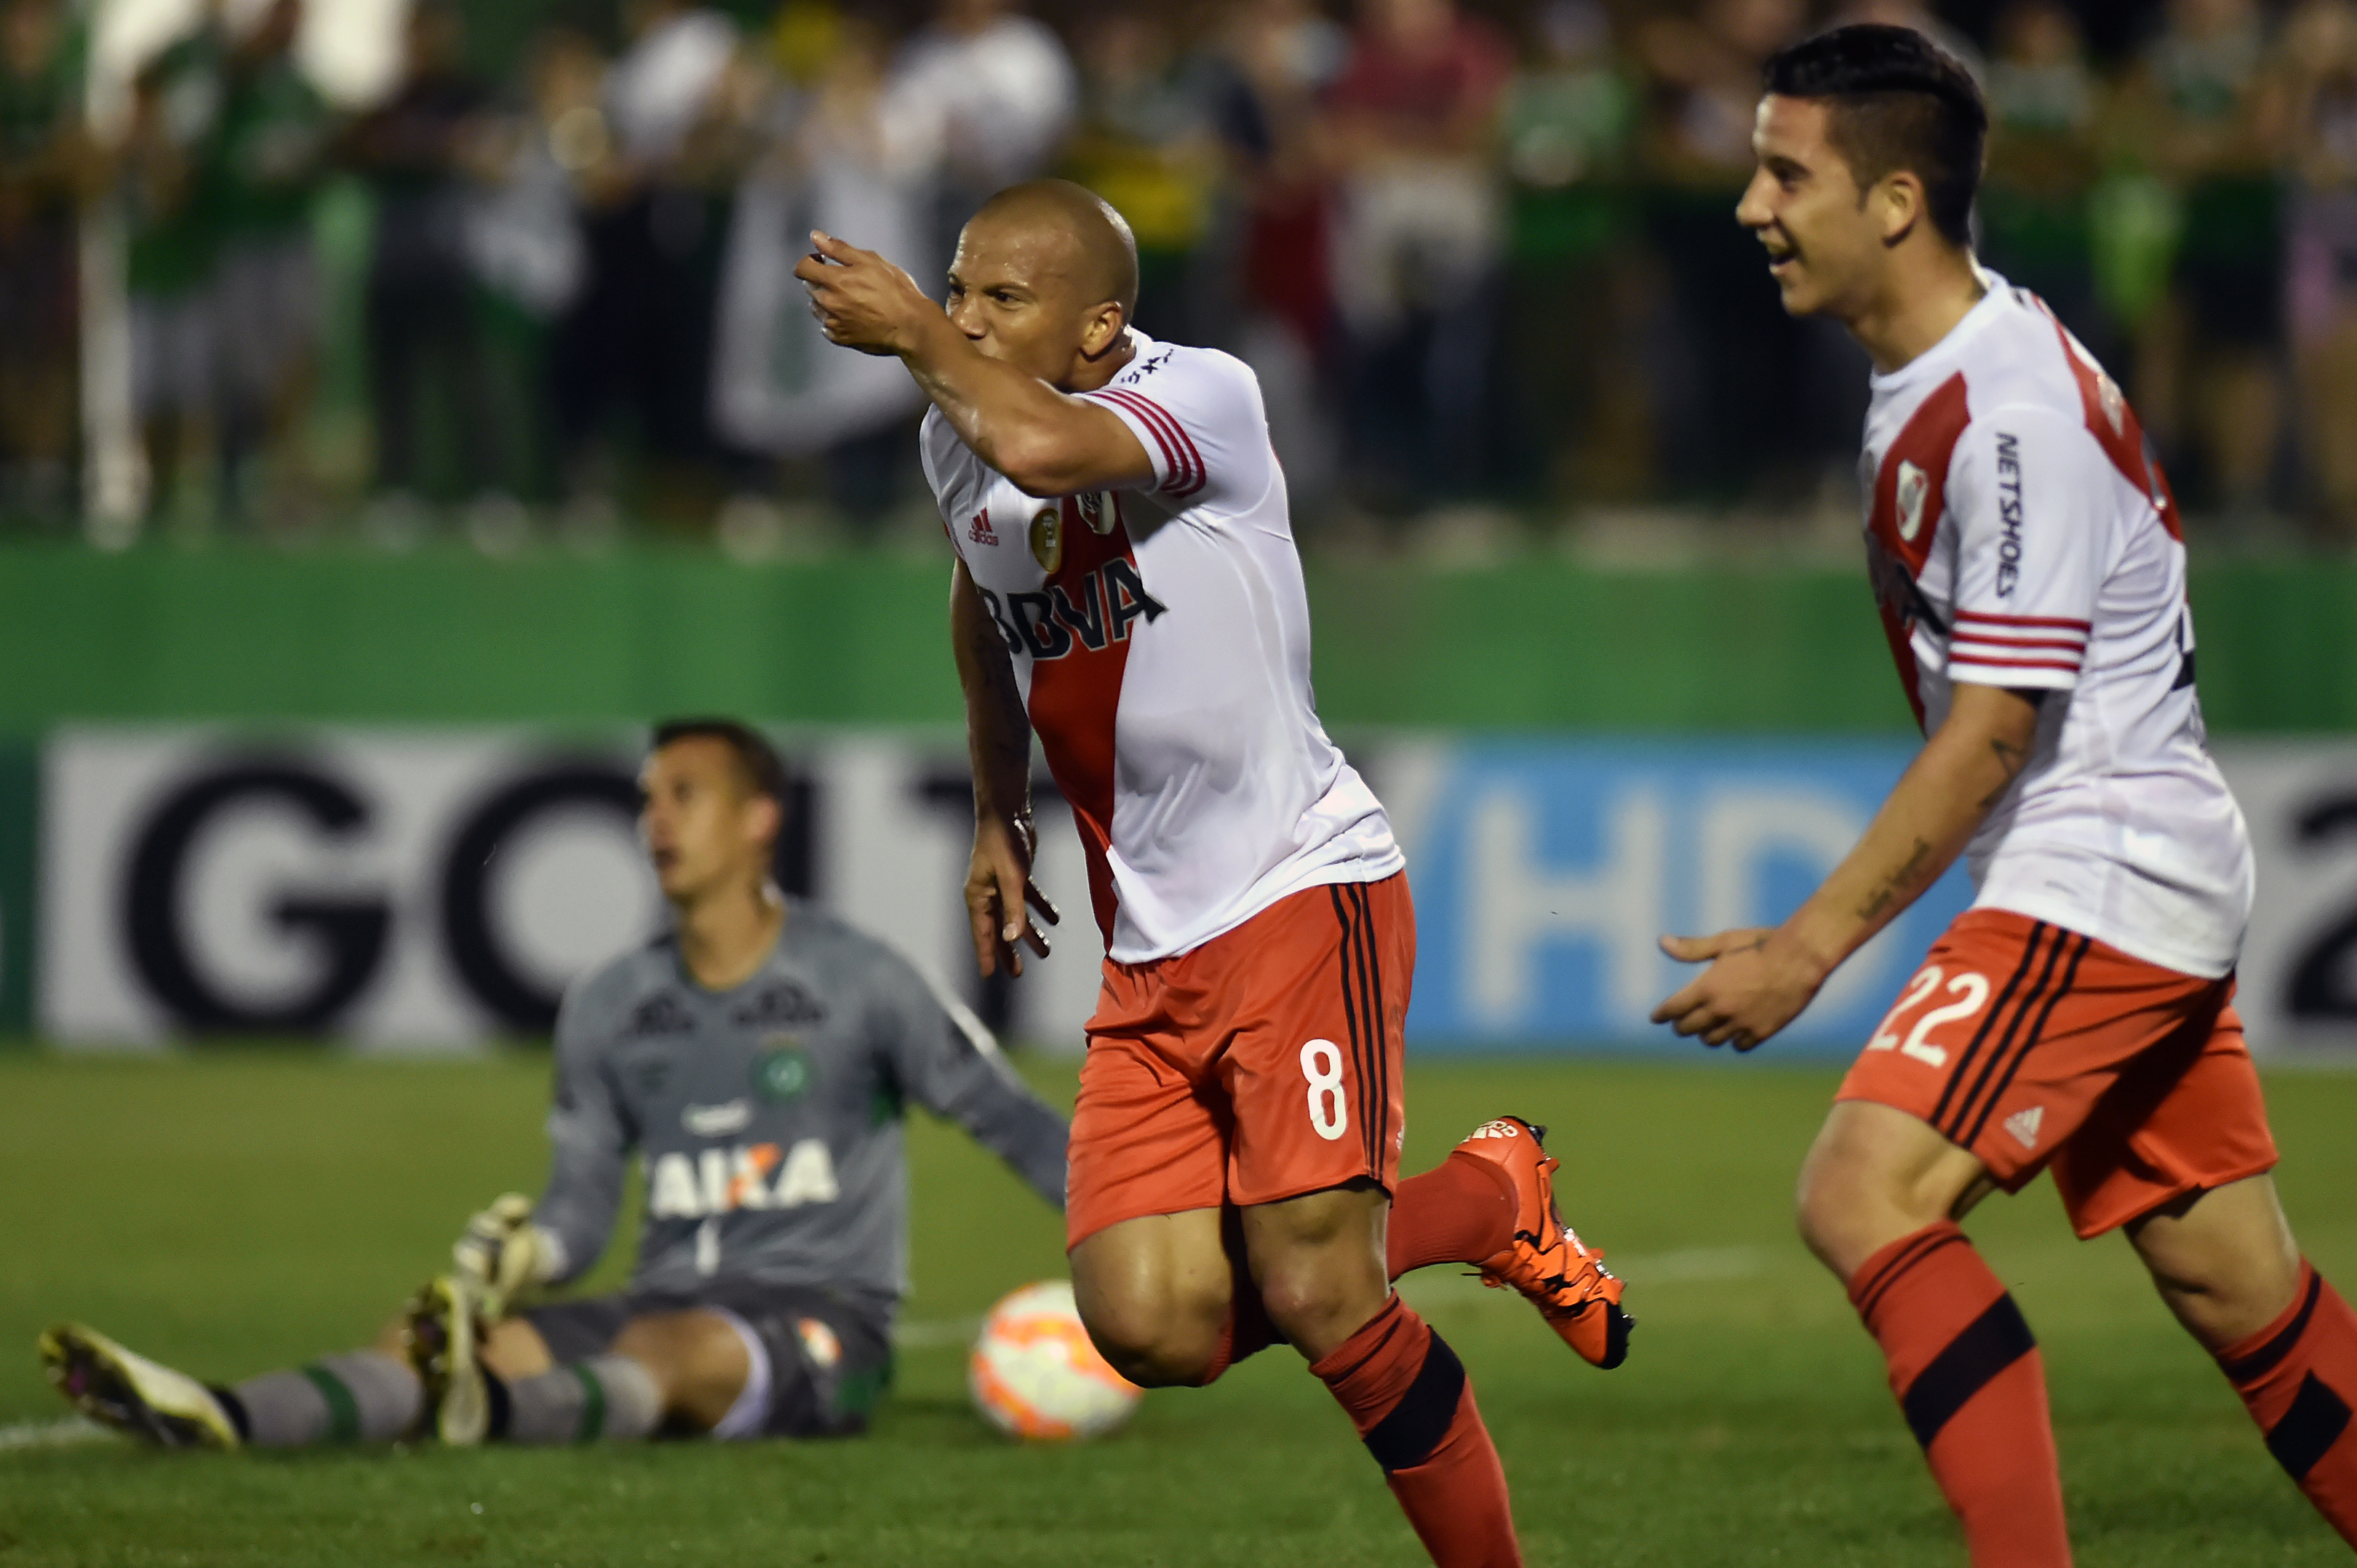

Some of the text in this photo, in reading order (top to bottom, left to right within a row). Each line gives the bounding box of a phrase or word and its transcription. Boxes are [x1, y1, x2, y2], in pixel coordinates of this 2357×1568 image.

[1996, 432, 2023, 599] NETSHOES
[1867, 965, 1990, 1068] 22
[1300, 1039, 1347, 1140] 8
